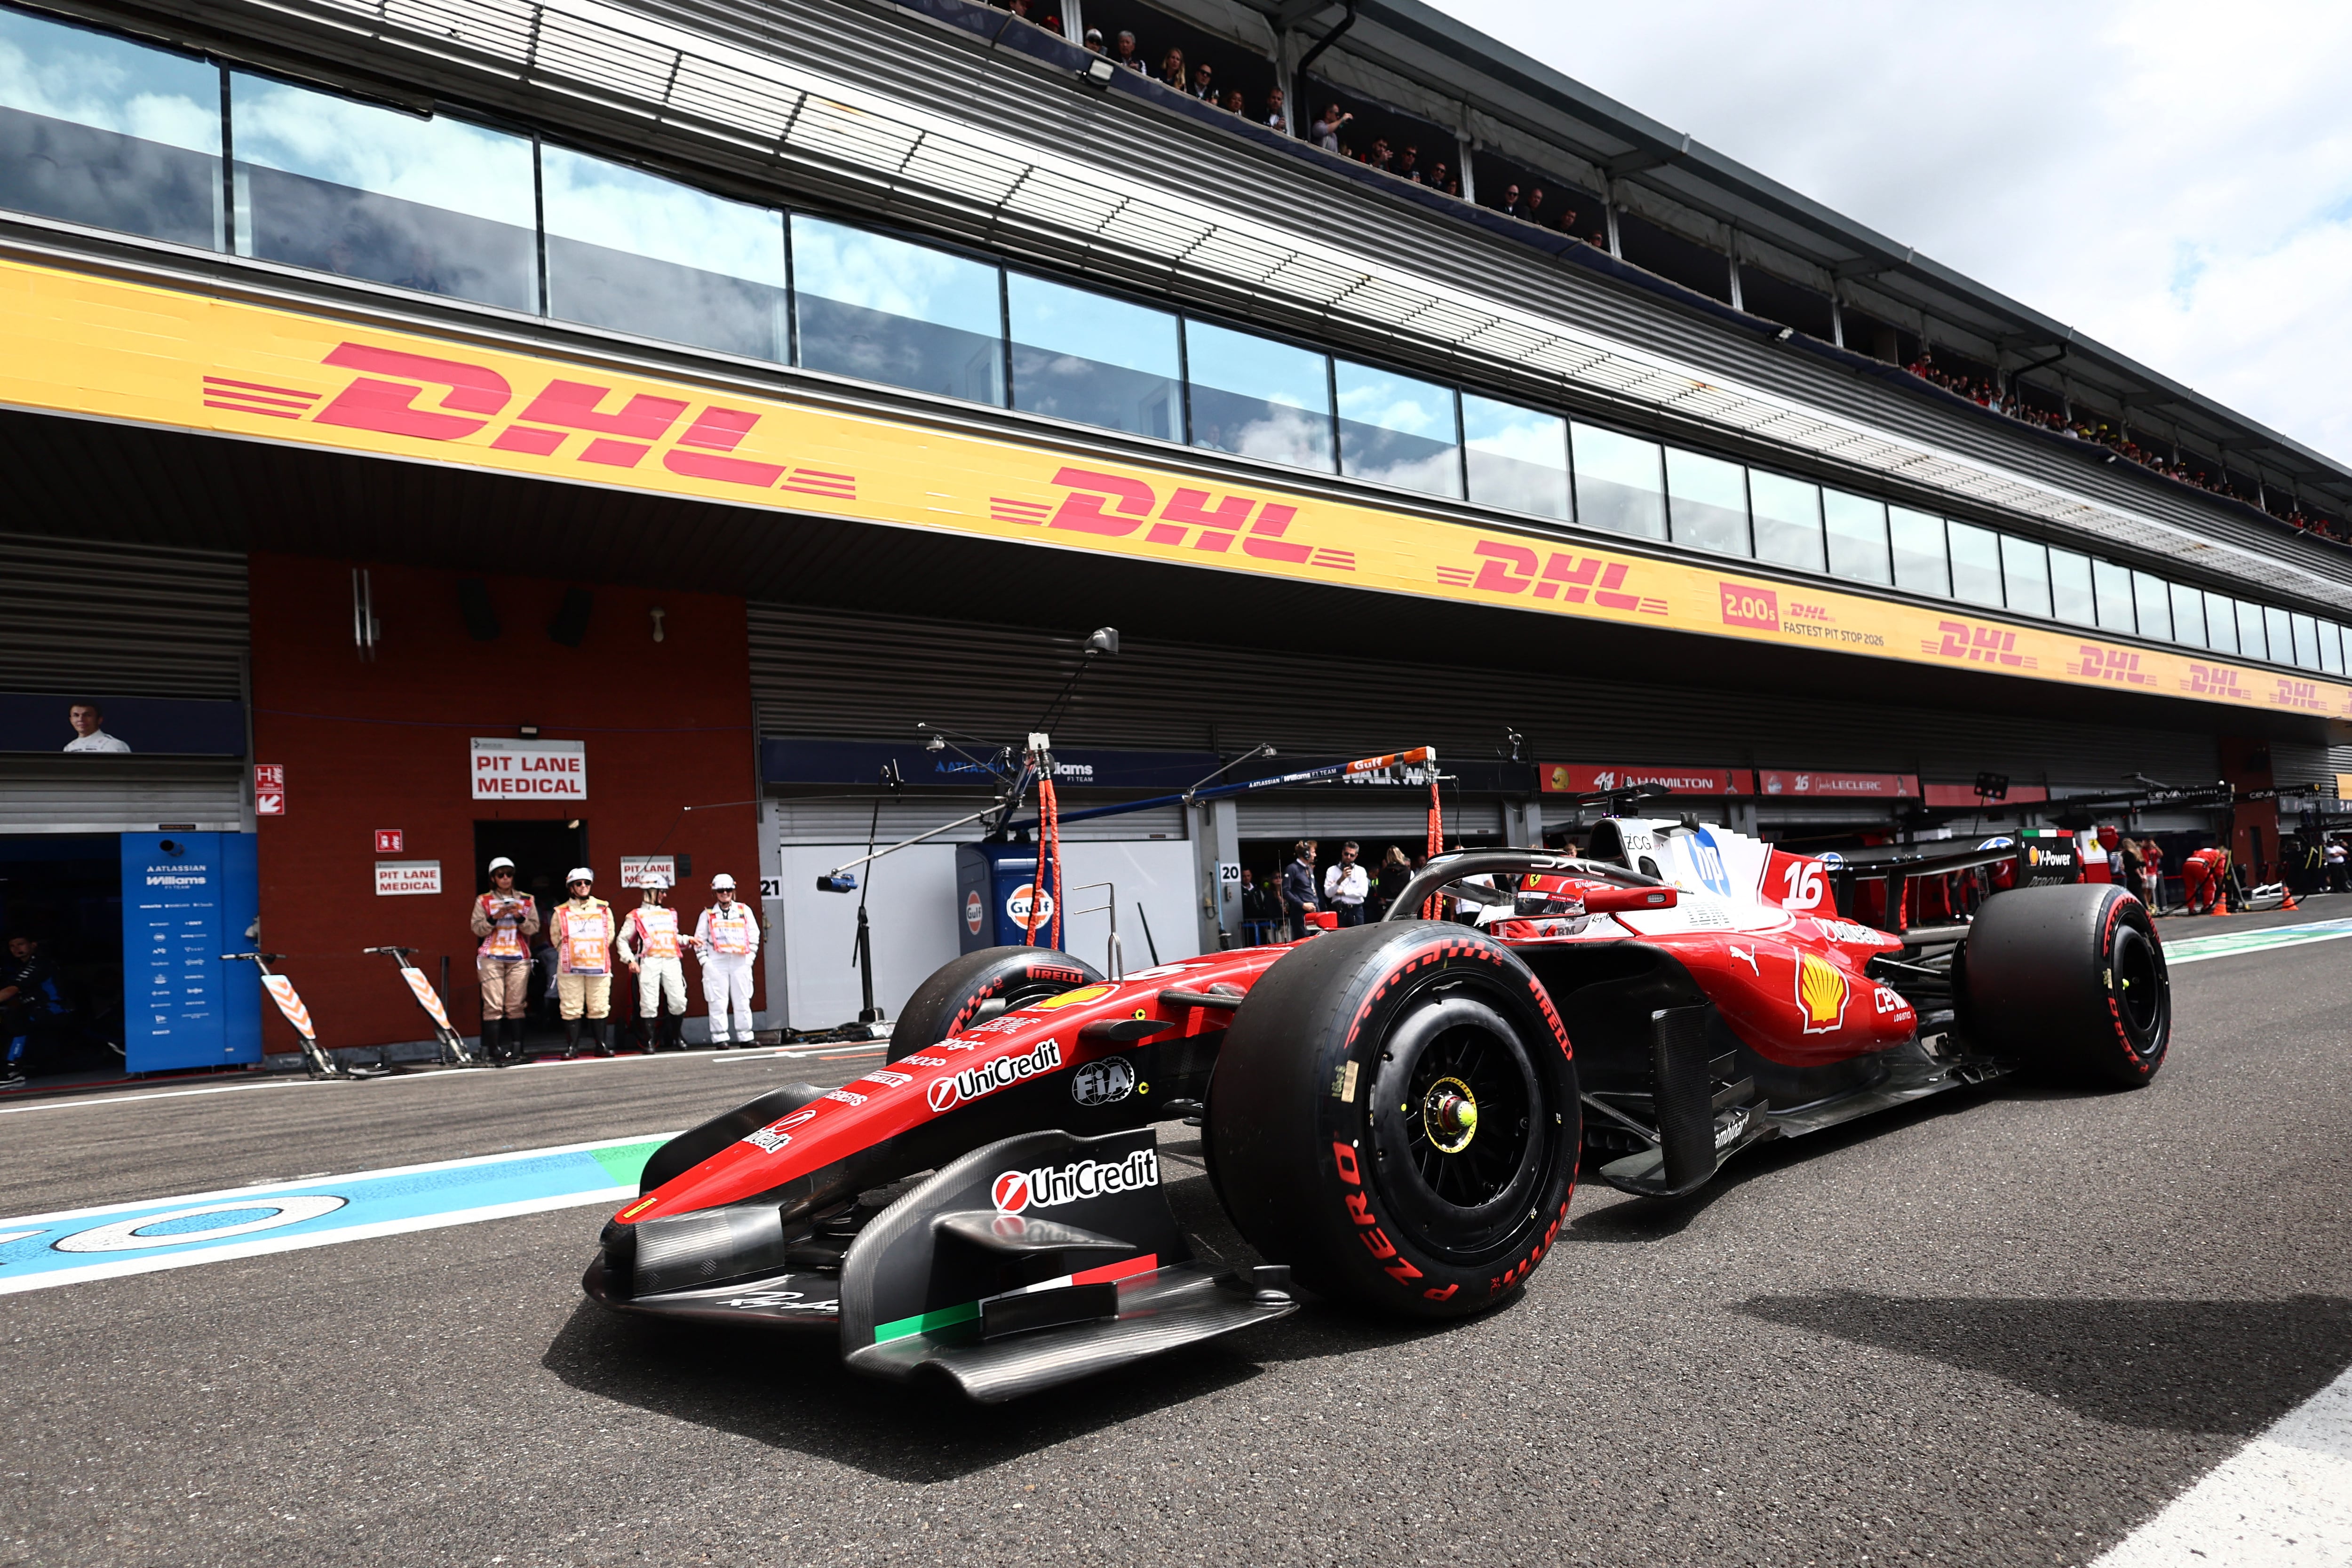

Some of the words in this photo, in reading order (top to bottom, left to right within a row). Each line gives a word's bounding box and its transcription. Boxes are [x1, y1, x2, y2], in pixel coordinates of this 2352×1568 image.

[312, 341, 787, 487] DHL
[1048, 467, 1314, 564] DHL
[1473, 540, 1640, 611] DHL
[1725, 593, 1776, 621] 2.00s
[1790, 603, 1828, 621] DHL
[1784, 622, 1822, 637] FASTEST
[1825, 628, 1838, 639] PIT
[1841, 630, 1862, 643] STOP
[1864, 634, 1884, 646] 2026
[1939, 621, 2023, 666] DHL
[2080, 645, 2145, 684] DHL
[2190, 664, 2242, 698] DHL
[2277, 679, 2320, 709] DHL
[477, 756, 512, 771] PIT
[522, 756, 580, 772] LANE
[1354, 757, 1383, 771] Gulf
[478, 778, 581, 793] MEDICAL
[1253, 778, 1280, 788] ATLASSIAN
[1284, 772, 1311, 783] Williams
[1594, 772, 1614, 788] 44
[1637, 777, 1714, 789] HAMILTON
[1795, 775, 1809, 791] 16
[1832, 780, 1882, 791] LECLERC
[1531, 854, 1606, 877] DXC
[2038, 850, 2071, 866] V-Power
[146, 876, 207, 886] Williams
[404, 870, 437, 879] LANE
[1222, 866, 1239, 879] 20
[380, 881, 437, 891] MEDICAL
[761, 880, 779, 896] 21
[1782, 861, 1823, 910] 16
[967, 907, 982, 919] Gulf
[1026, 962, 1084, 984] PIRELLI
[1528, 975, 1573, 1060] PIRELLI
[1894, 1011, 1911, 1023] LOGISTICS
[958, 1042, 1059, 1098] UniCredit
[1032, 1153, 1154, 1204] UniCredit
[1333, 1140, 1423, 1286] ZERO
[1423, 1283, 1459, 1302] P
